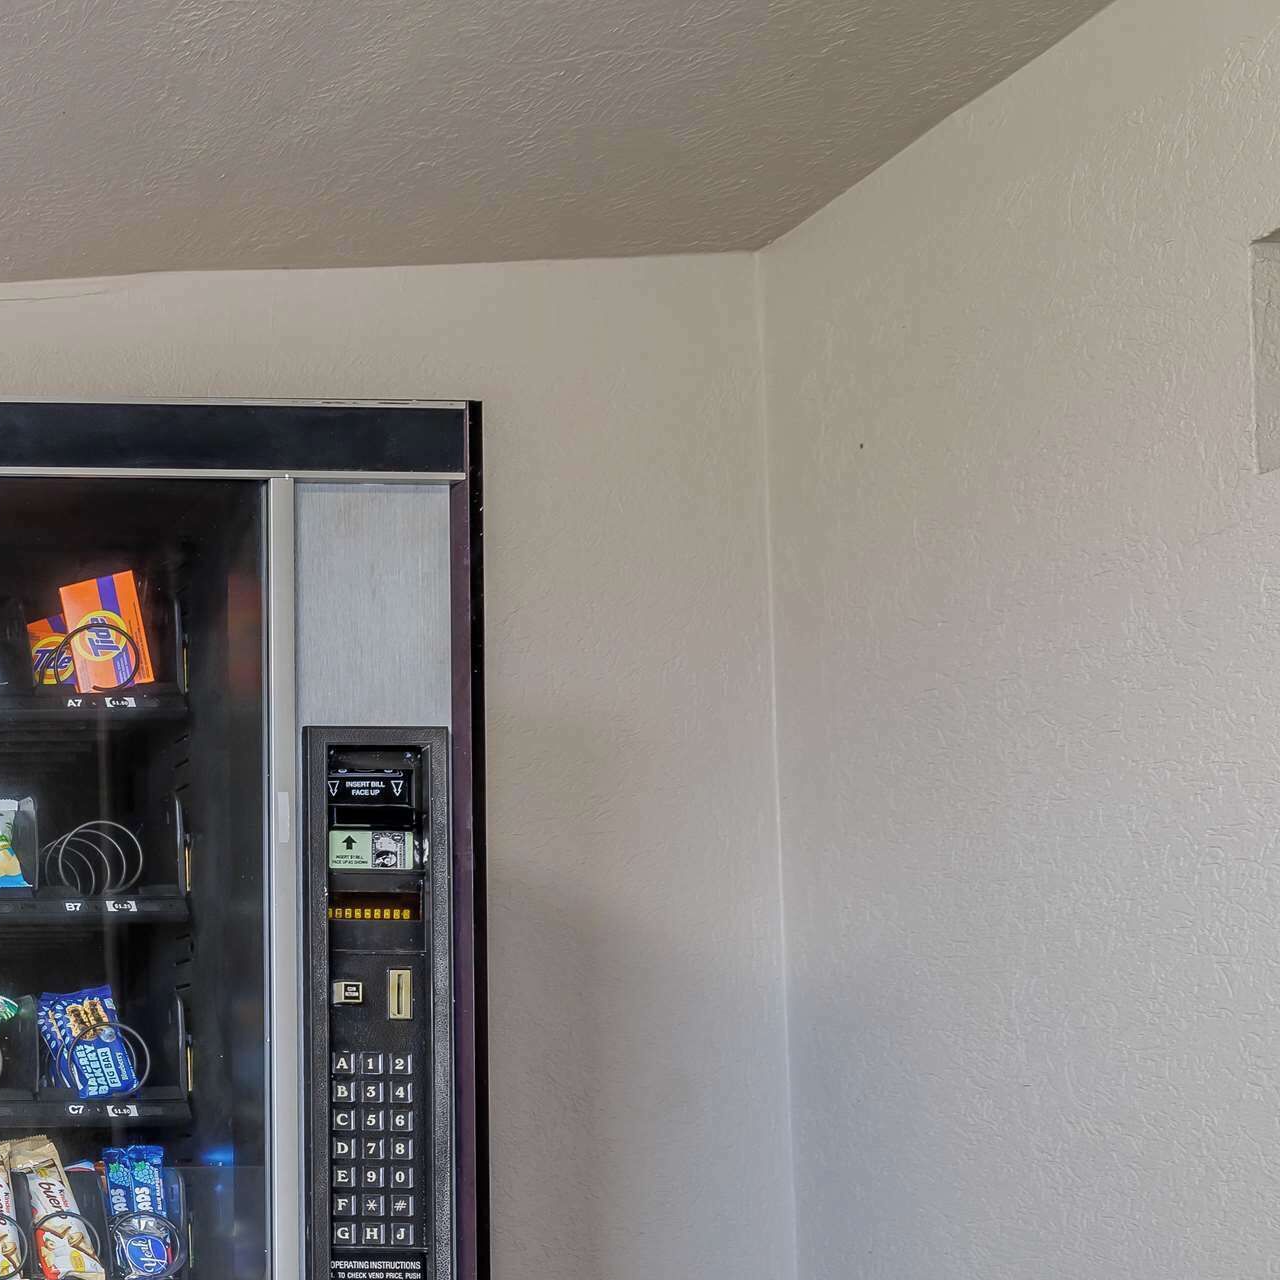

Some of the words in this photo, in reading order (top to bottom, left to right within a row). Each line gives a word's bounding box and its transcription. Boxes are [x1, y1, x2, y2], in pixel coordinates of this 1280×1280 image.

[67, 699, 82, 707] A7
[65, 903, 81, 911] B7
[101, 1050, 113, 1068] BAR
[336, 1057, 349, 1069] A
[367, 1057, 374, 1070] 1
[394, 1058, 405, 1070] 2
[106, 1068, 119, 1084] FIG
[336, 1085, 349, 1097] B
[366, 1086, 376, 1097] 3
[395, 1086, 405, 1098] 4
[69, 1105, 84, 1114] C7
[336, 1113, 349, 1125] C
[366, 1114, 376, 1126] 5
[395, 1114, 405, 1126] 6
[336, 1142, 349, 1153] D
[366, 1143, 376, 1154] 7
[395, 1143, 405, 1154] 8
[336, 1170, 349, 1182] E
[366, 1171, 377, 1182] 9
[395, 1171, 405, 1182] 0
[337, 1199, 348, 1210] F
[336, 1227, 350, 1239] G
[365, 1227, 378, 1239] H
[396, 1228, 406, 1240] J
[330, 1261, 369, 1269] OPERATING
[369, 1261, 421, 1269] INSTRUCTIONS
